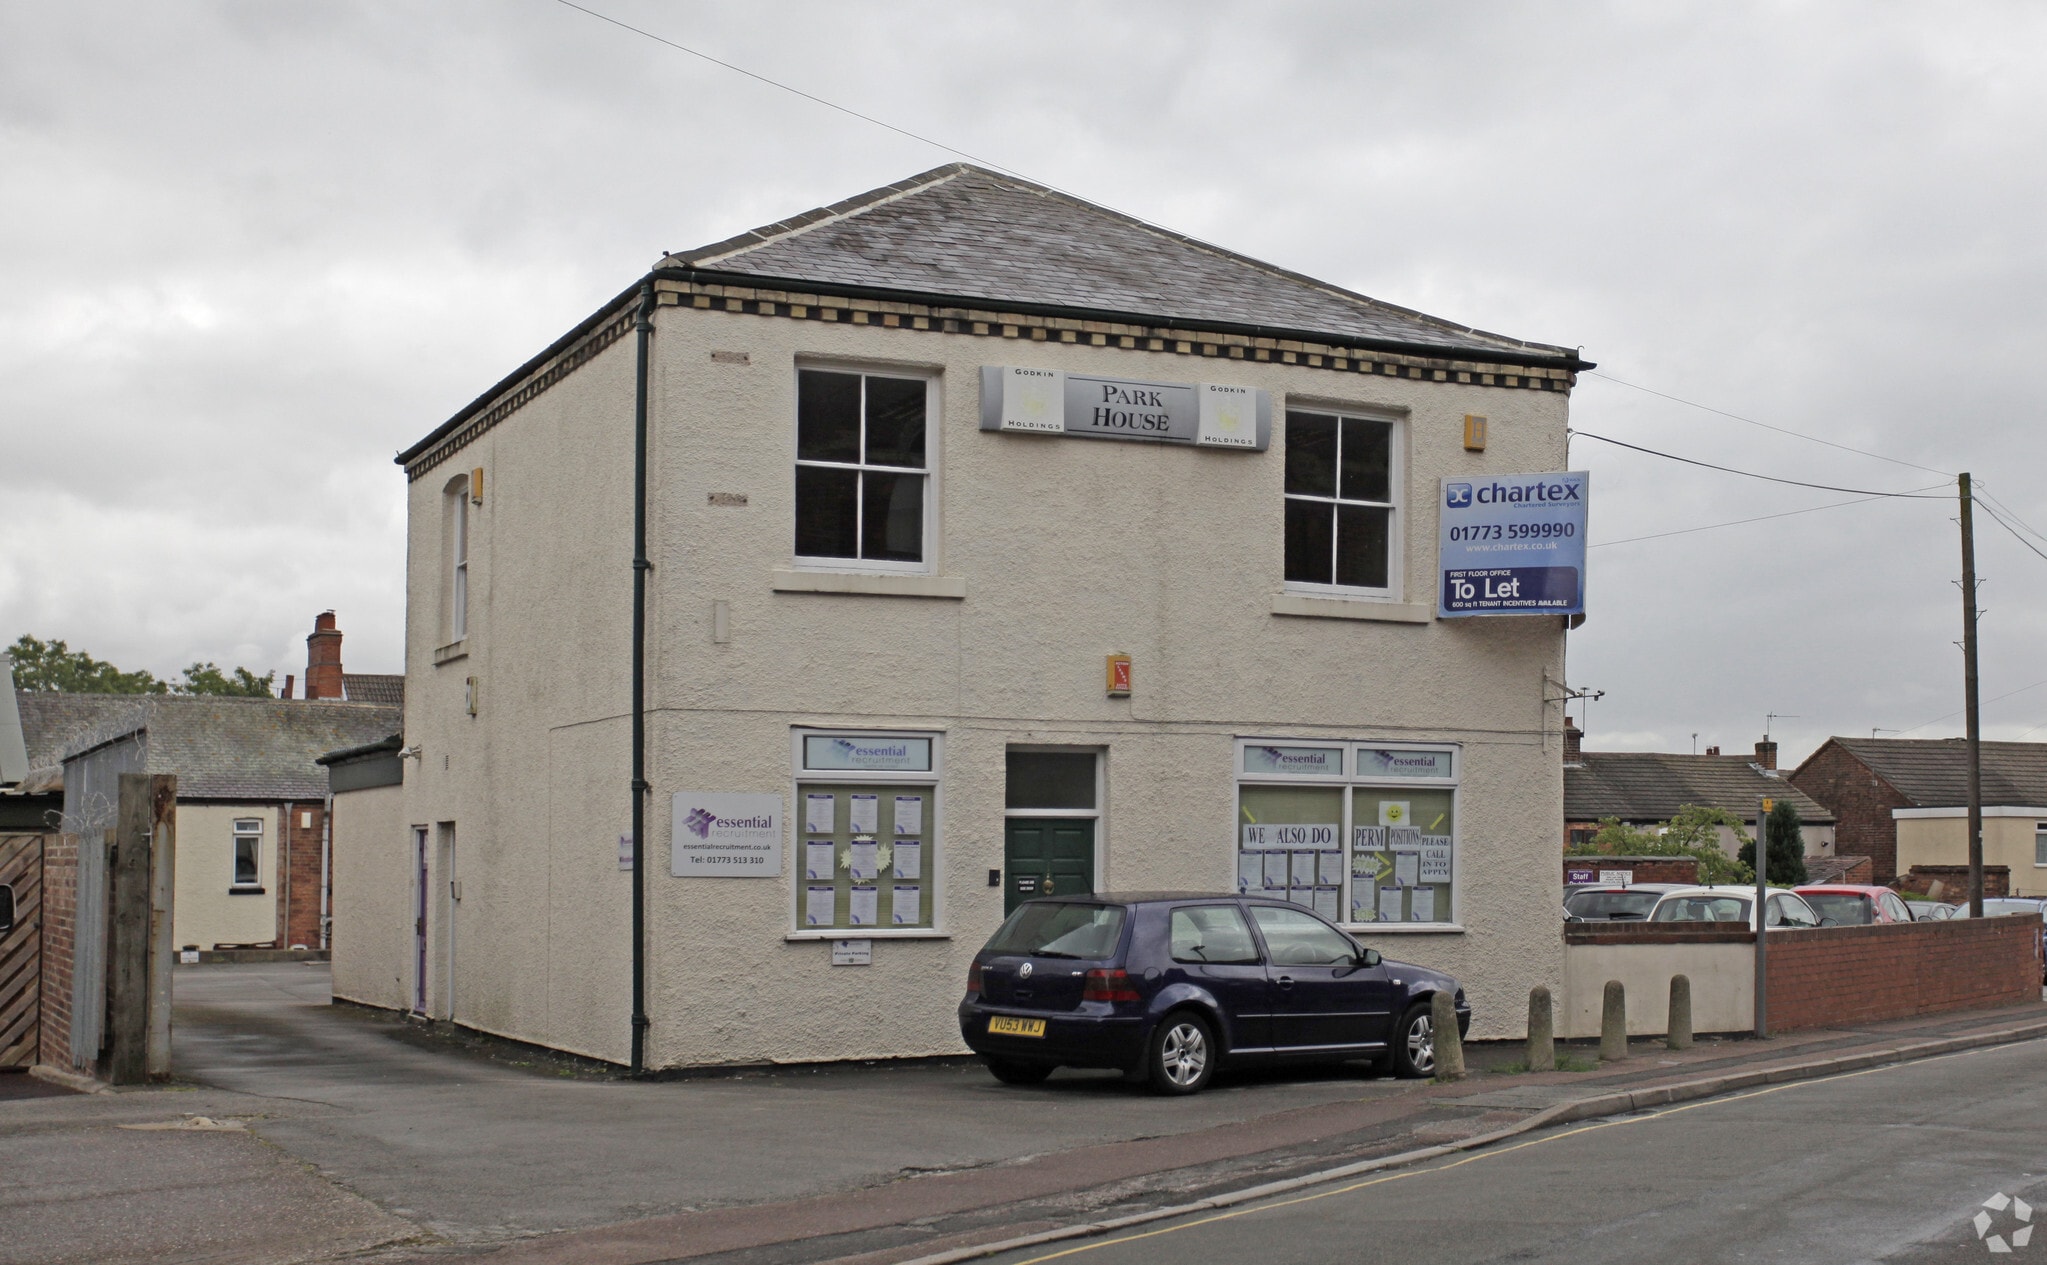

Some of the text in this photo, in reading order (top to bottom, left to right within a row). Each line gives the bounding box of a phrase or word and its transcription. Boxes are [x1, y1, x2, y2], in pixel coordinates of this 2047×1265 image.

[1015, 368, 1054, 377] GODKIN
[1210, 385, 1246, 394] GODKIN
[1102, 384, 1163, 408] PARK
[1092, 407, 1170, 432] HOUSE
[1008, 420, 1061, 430] HOLDINGS
[1205, 435, 1253, 445] HOLDINGS
[1477, 481, 1580, 504] chartex
[1450, 522, 1575, 541] 01773 599990
[1465, 542, 1558, 552] www.chartex.co.uk
[1450, 577, 1520, 599] To Let
[856, 745, 906, 756] essential
[851, 756, 911, 765] recruitment
[1282, 753, 1326, 764] essential
[1393, 756, 1436, 767] essential
[1278, 763, 1329, 771] recruitment
[1390, 766, 1439, 774] recruitment
[716, 815, 772, 829] essential
[711, 829, 776, 839] recruitment
[1248, 827, 1331, 844] WE ALSO DO
[1355, 828, 1420, 847] PERM POSITIONS
[1421, 837, 1449, 846] PLEASE
[683, 843, 771, 851] essentialrecruitment.co.uk
[1425, 850, 1446, 859] CALL
[690, 856, 764, 864] Tel: 01773 513 310
